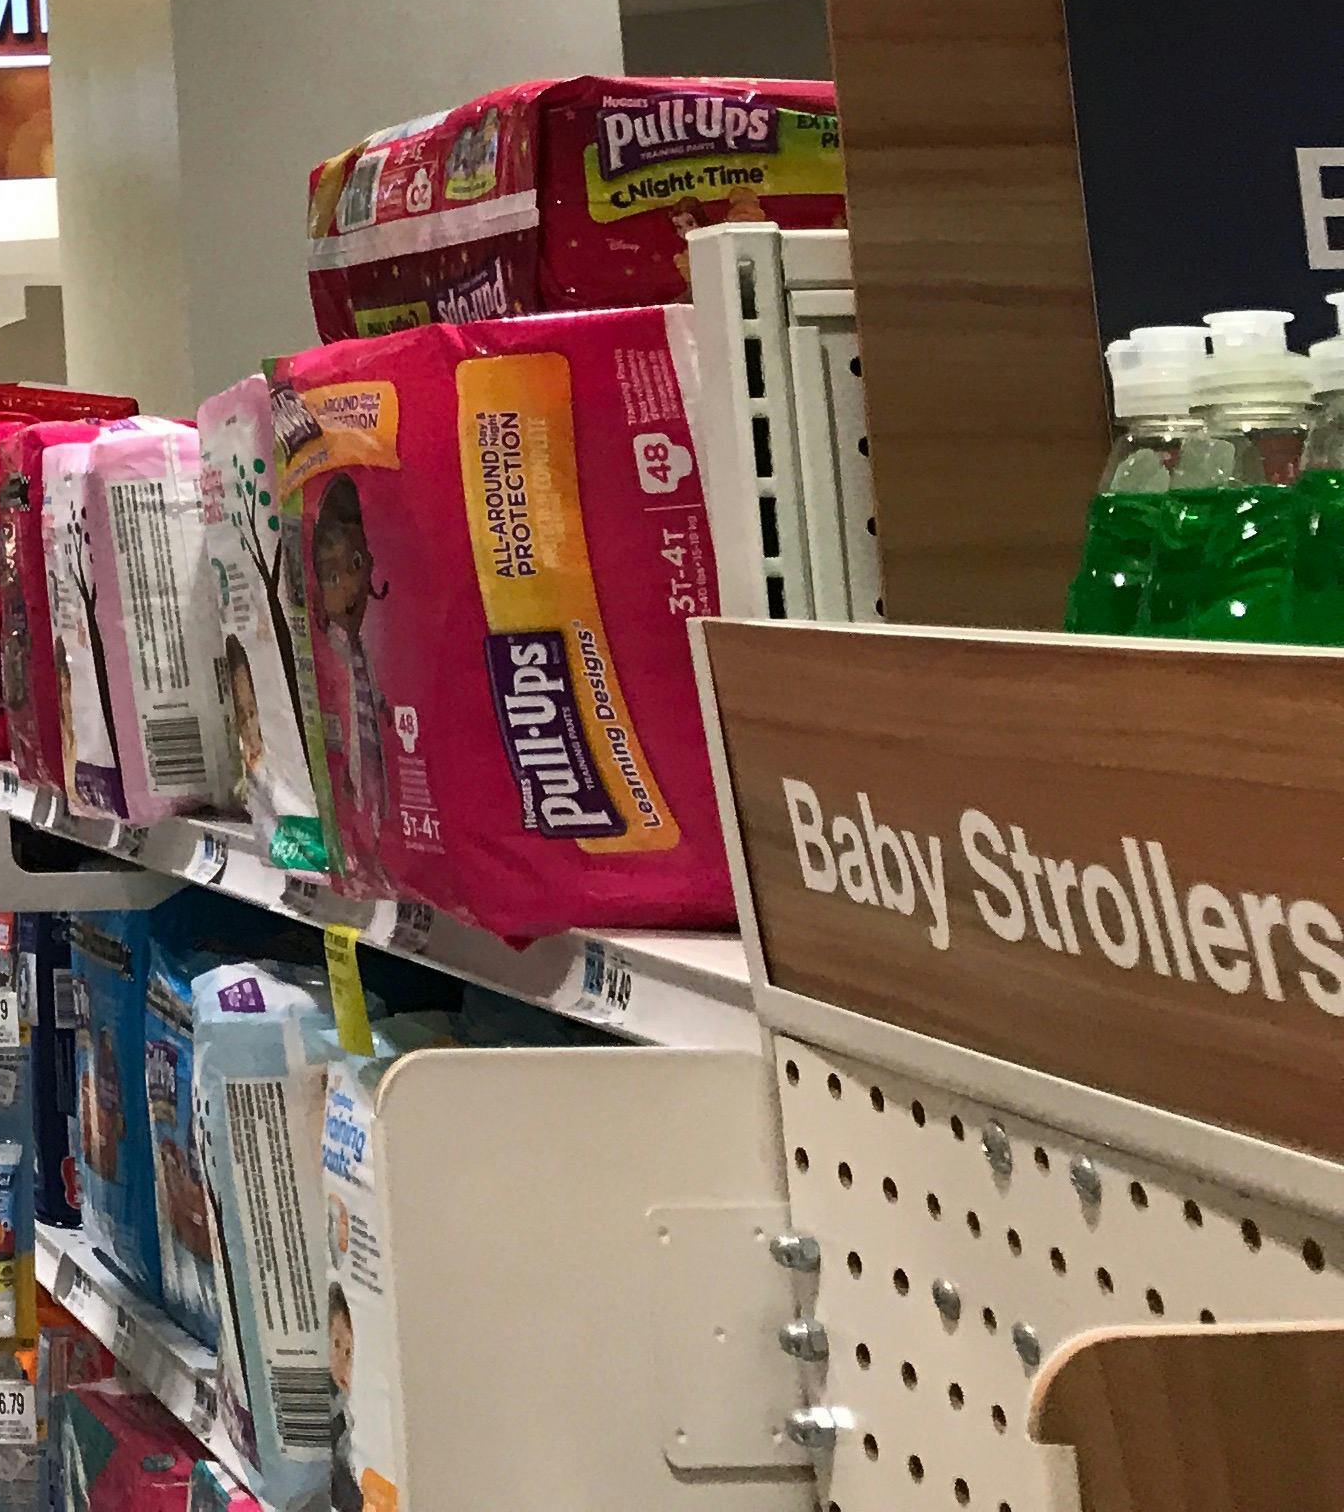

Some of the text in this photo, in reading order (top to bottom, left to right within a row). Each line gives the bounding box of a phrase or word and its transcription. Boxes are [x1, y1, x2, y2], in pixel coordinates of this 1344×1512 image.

[481, 449, 515, 578] ALL-AROUND
[499, 412, 537, 577] PROTECTION
[643, 442, 671, 484] 48
[661, 528, 696, 615] 3T-4T
[398, 713, 415, 735] 48
[578, 629, 662, 830] Learning Designs
[782, 777, 1344, 1018] Baby Strollers
